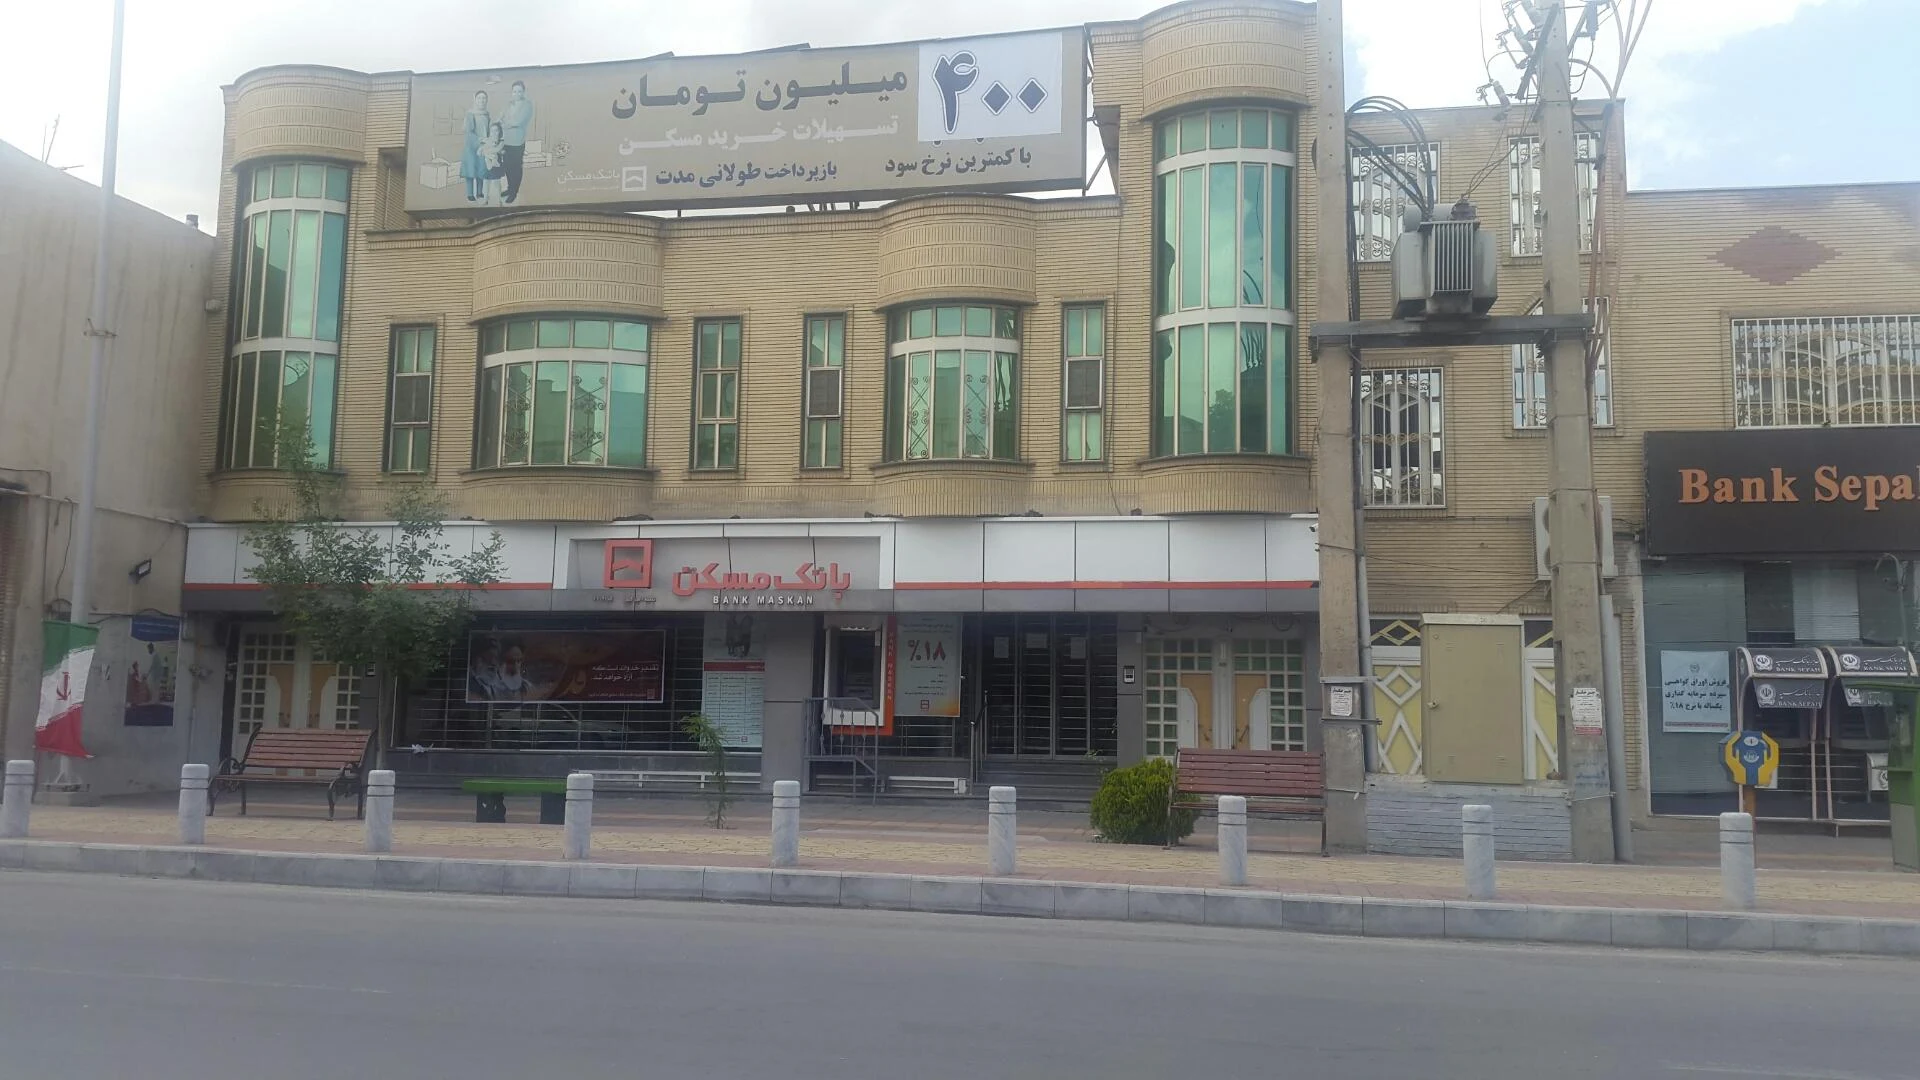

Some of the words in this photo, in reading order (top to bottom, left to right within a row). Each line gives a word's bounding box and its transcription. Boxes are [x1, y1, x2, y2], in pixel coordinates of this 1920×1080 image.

[612, 69, 746, 119] تومان
[756, 61, 907, 110] میلیون
[933, 50, 1048, 134] ۴۰۰
[619, 127, 703, 155] مسکن
[708, 121, 787, 151] خرید
[793, 115, 899, 143] تسهیلات
[885, 159, 918, 177] سود
[921, 152, 952, 175] نرخ
[955, 148, 1015, 174] کمترین
[1019, 147, 1032, 168] با
[557, 171, 592, 184] مسکن
[593, 168, 620, 182] بانک
[656, 169, 695, 184] مدت
[699, 162, 761, 187] طولانی
[765, 161, 837, 182] بازپرداخت
[1678, 467, 1799, 504] Bank
[1814, 464, 1920, 512] Sepa
[672, 562, 772, 597] مسکن
[773, 562, 851, 601] بانک
[713, 595, 750, 605] BANK
[757, 595, 814, 605] MASKAN
